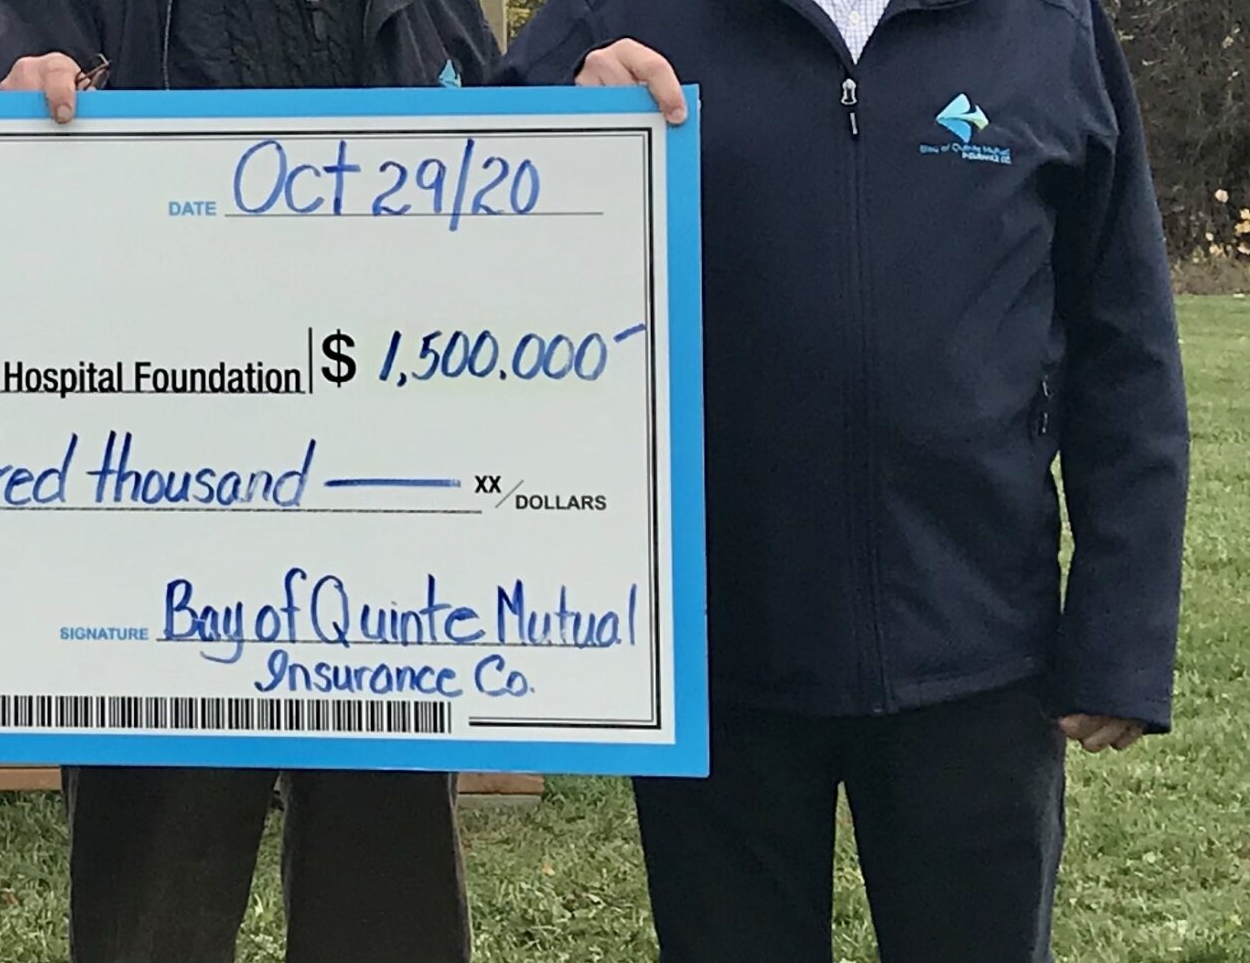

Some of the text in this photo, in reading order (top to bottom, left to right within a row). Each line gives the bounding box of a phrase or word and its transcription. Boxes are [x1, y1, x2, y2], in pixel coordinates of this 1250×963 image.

[168, 201, 217, 217] DATE
[233, 138, 541, 232] Oct 29/20
[3, 361, 123, 398] Hospital
[135, 361, 302, 394] Foundation
[321, 328, 356, 388] $
[87, 429, 317, 508] thousand
[515, 495, 607, 511] DOLLARS
[59, 626, 149, 641] SIGNATURE
[163, 567, 636, 664] Bay of Quinte Mutual
[254, 649, 534, 697] Insurance Co.
